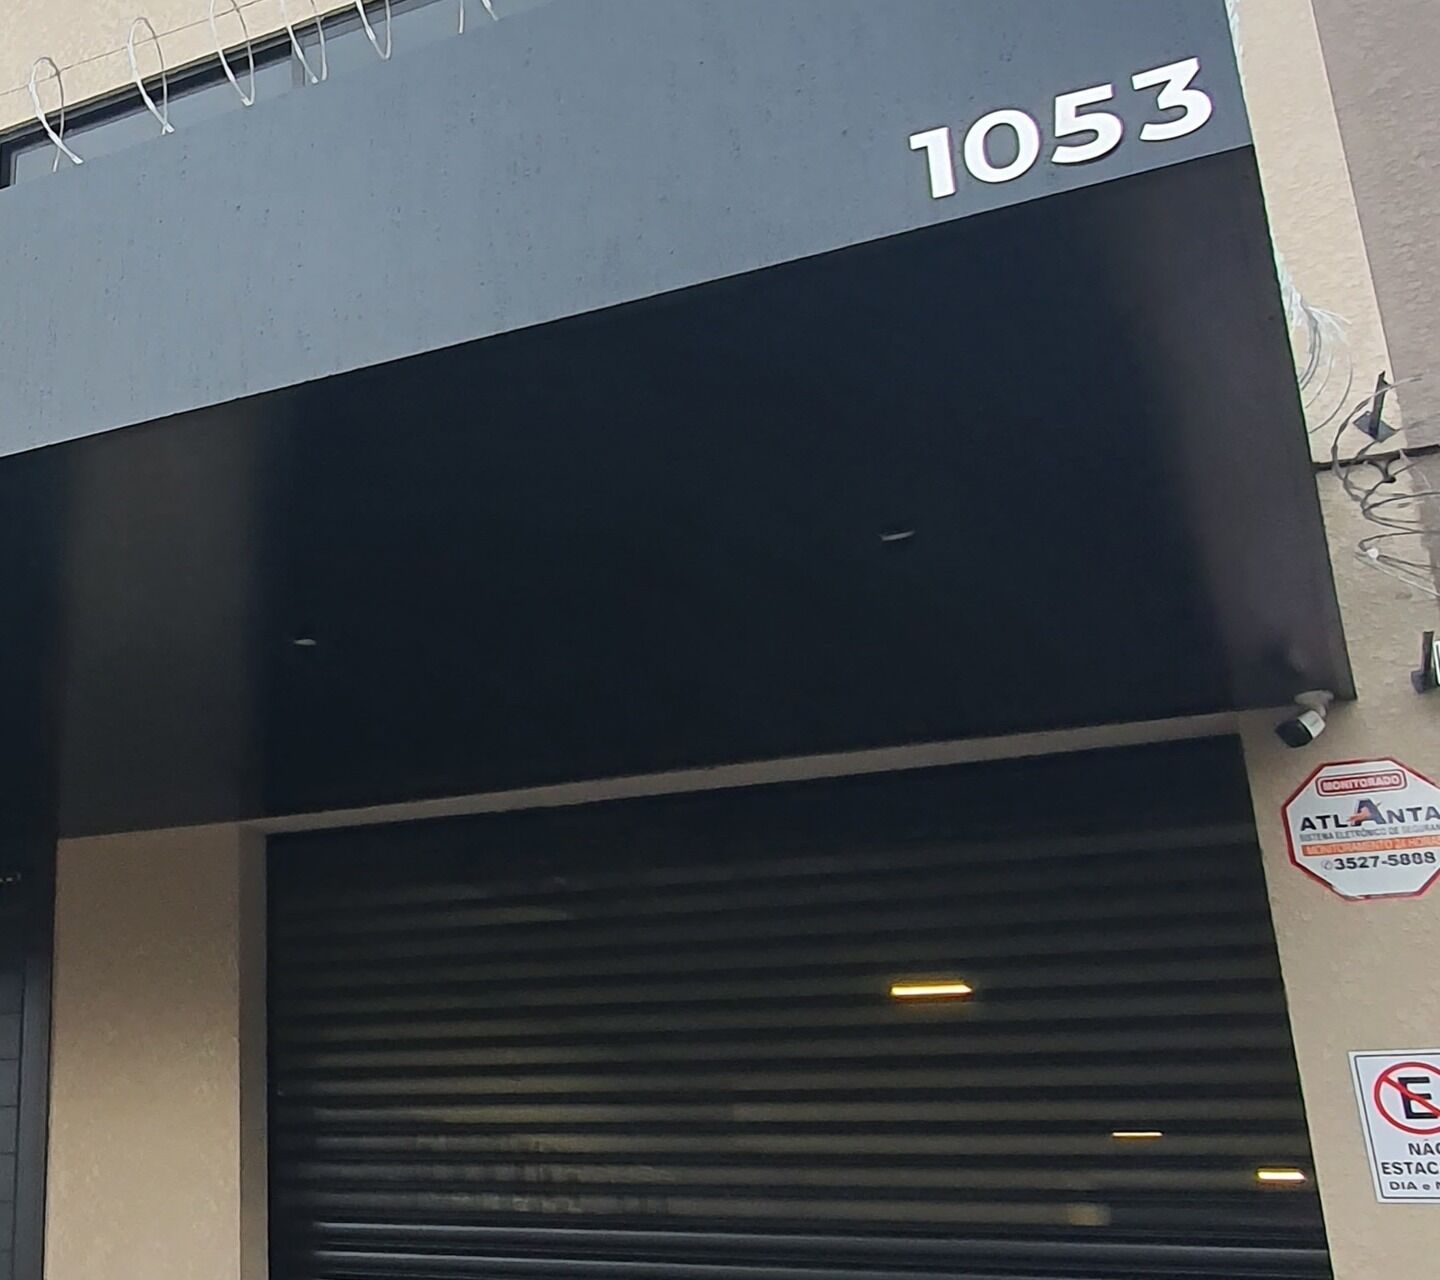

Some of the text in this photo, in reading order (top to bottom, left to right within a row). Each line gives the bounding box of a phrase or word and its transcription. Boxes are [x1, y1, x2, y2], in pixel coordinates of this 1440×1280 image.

[909, 57, 1214, 200] 1053
[1322, 774, 1401, 791] MONITORADO
[1300, 798, 1440, 831] ATLANTA
[1333, 851, 1437, 870] 3527-5888
[1389, 1181, 1418, 1191] DIA
